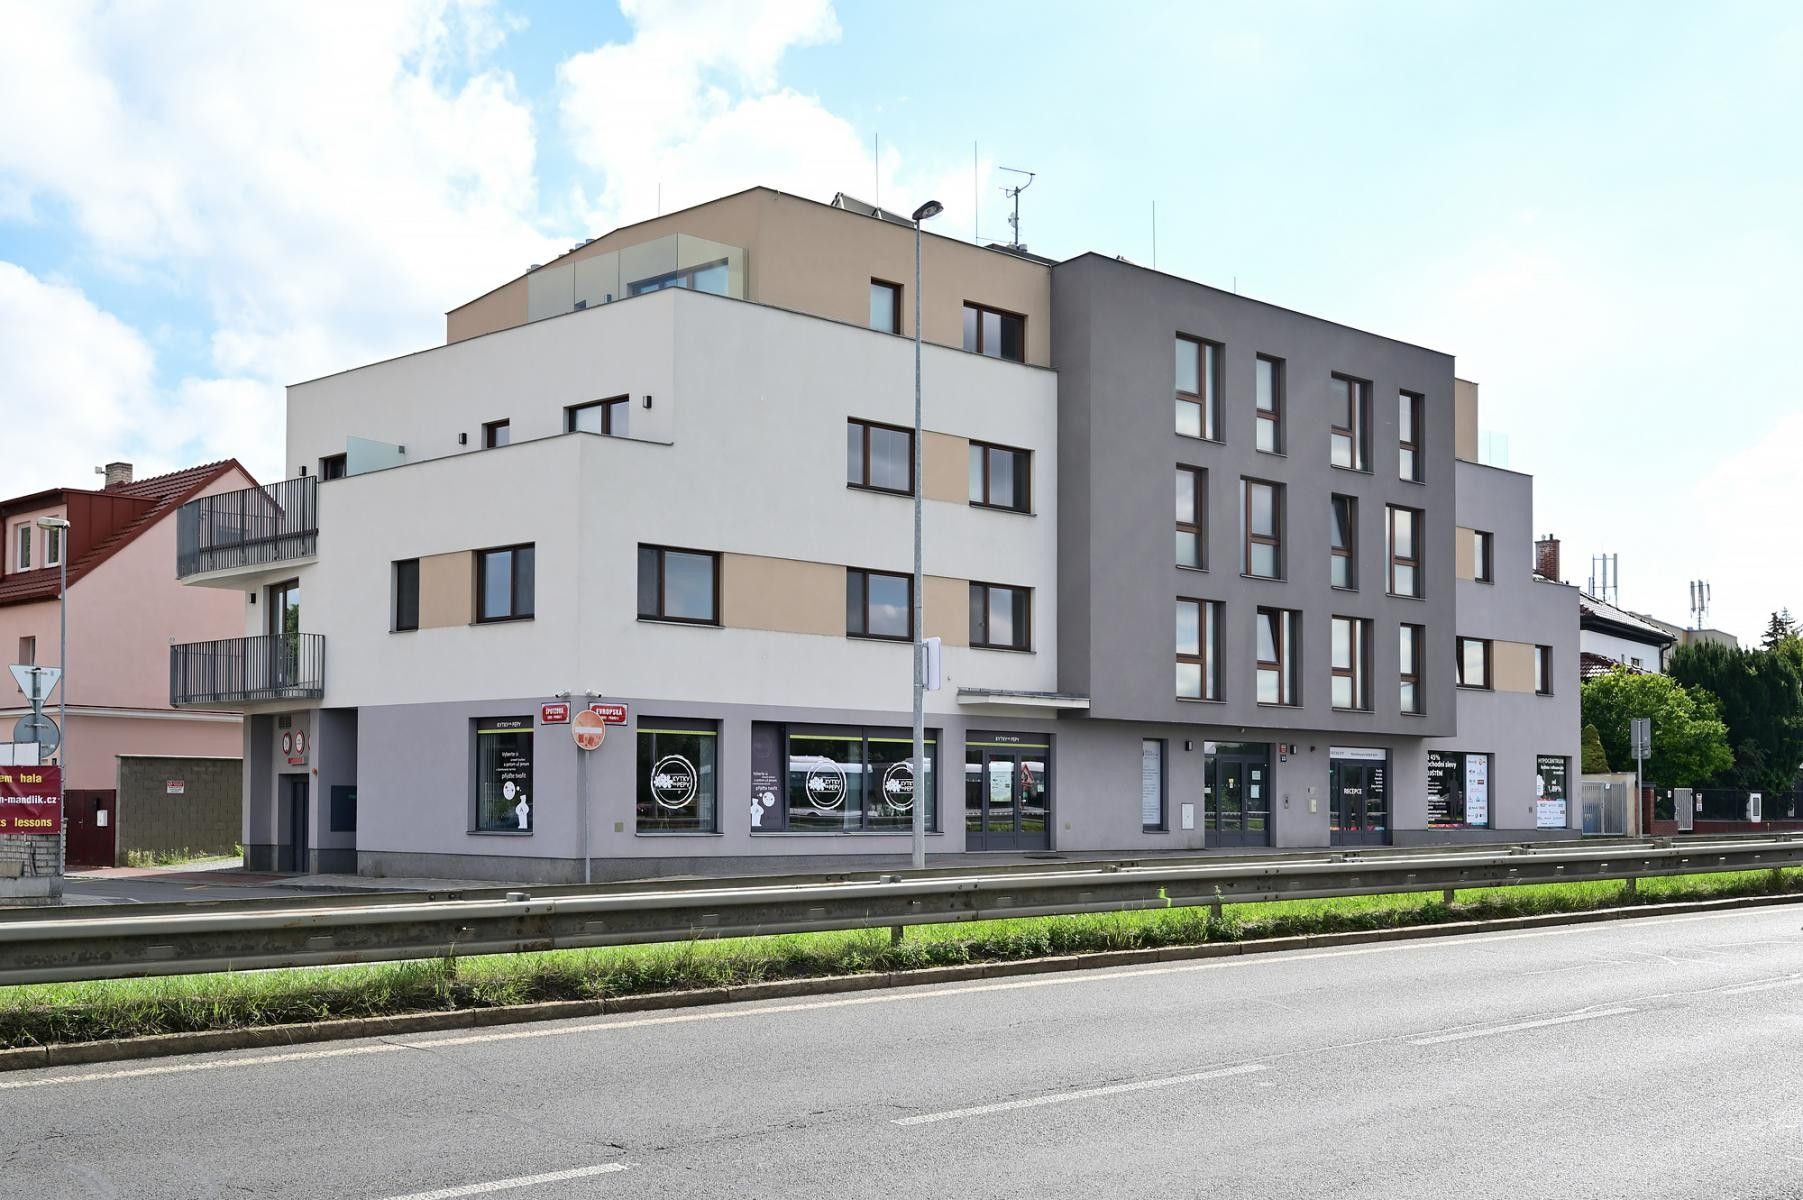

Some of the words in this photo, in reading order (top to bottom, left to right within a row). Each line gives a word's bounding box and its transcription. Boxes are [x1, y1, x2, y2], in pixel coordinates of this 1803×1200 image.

[1445, 760, 1456, 769] slevy
[21, 774, 42, 783] hala
[14, 817, 52, 827] lessons
